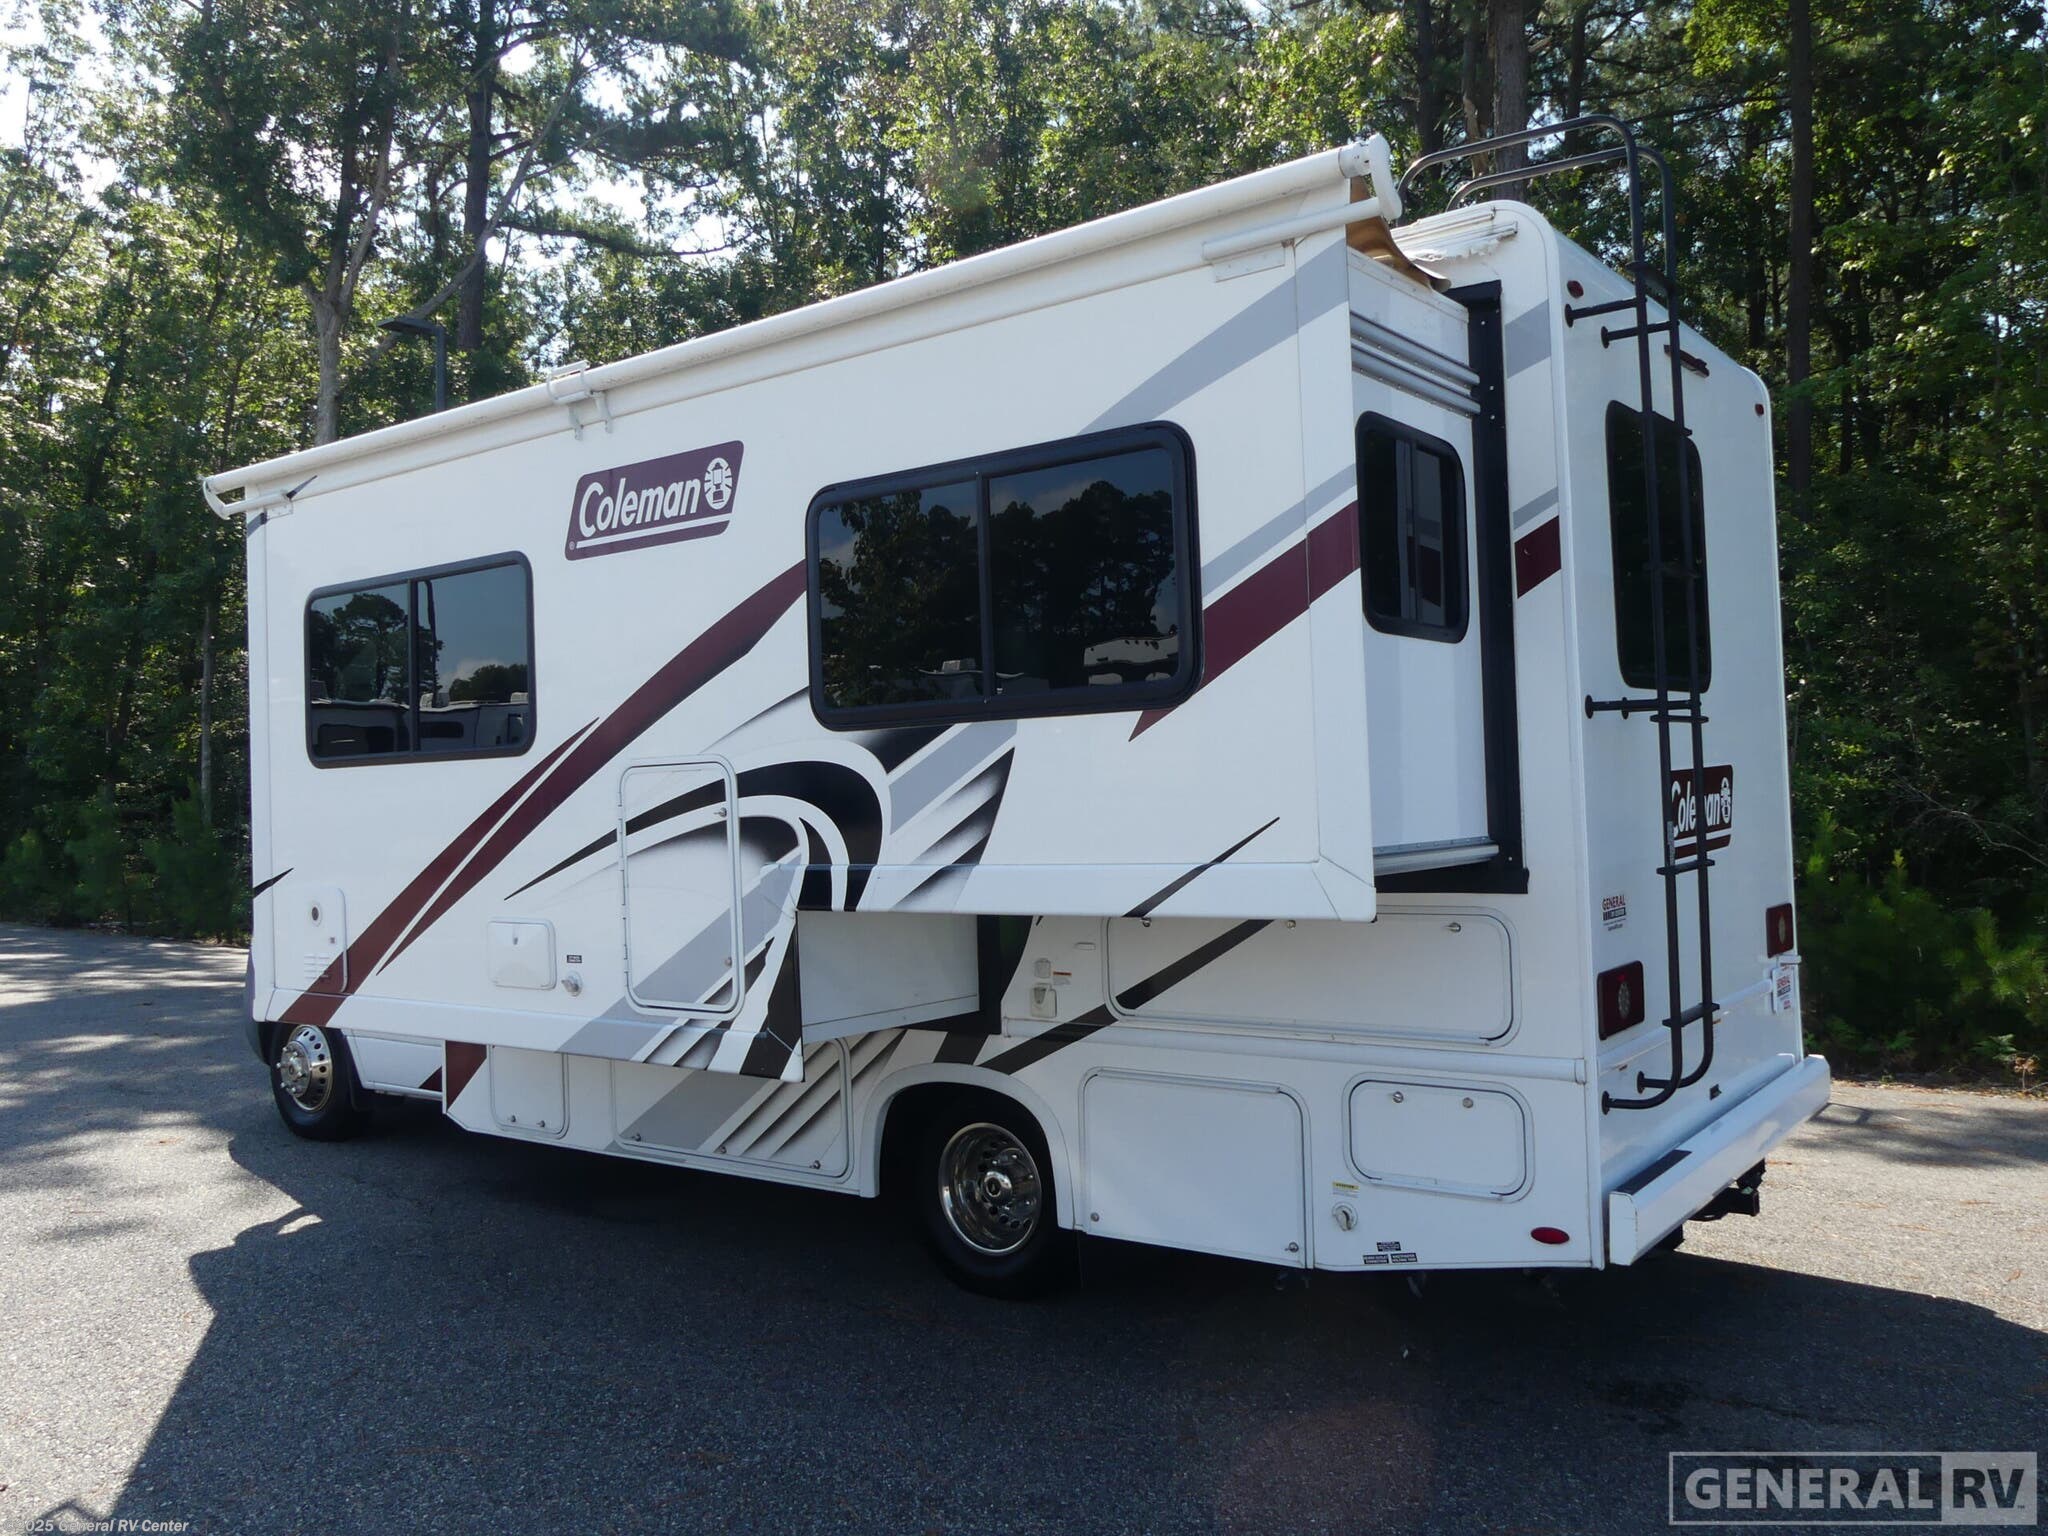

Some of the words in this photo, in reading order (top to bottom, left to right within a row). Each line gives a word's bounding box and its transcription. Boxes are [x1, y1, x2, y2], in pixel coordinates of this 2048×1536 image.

[579, 477, 701, 538] Coleman
[1671, 780, 1721, 838] Colean
[1602, 894, 1626, 911] GENERAL
